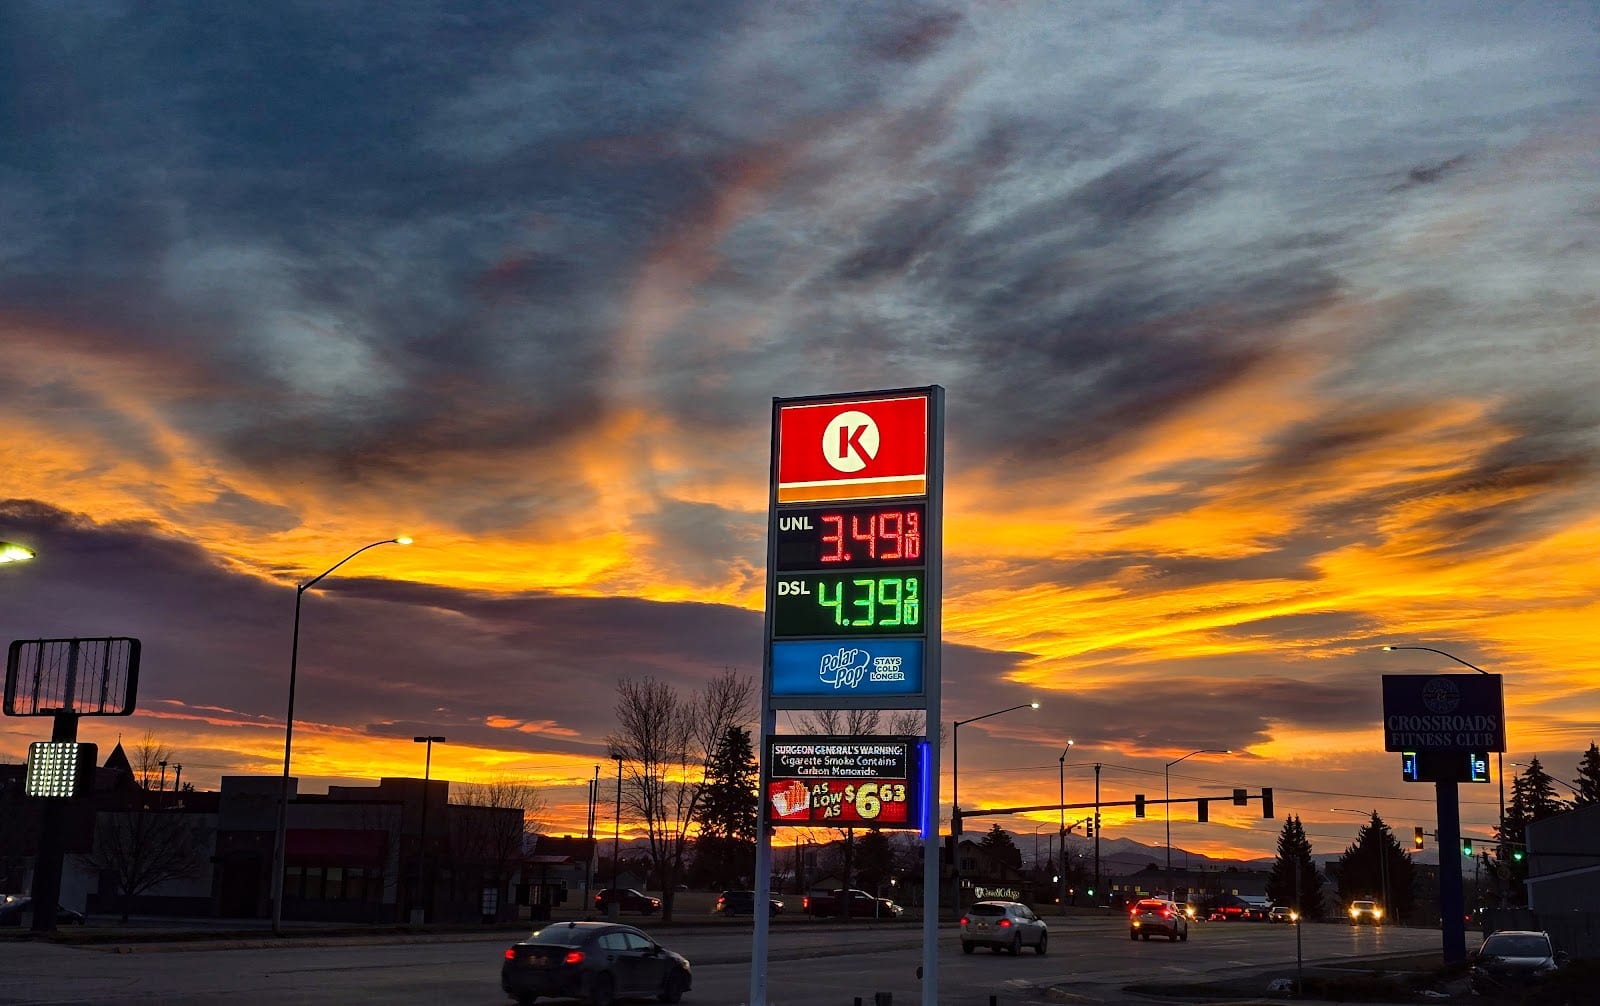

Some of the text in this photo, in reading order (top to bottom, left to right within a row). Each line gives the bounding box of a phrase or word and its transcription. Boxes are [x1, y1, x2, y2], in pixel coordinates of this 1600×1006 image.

[779, 517, 813, 531] UNL
[777, 581, 811, 596] DSL
[820, 648, 859, 674] Polar
[874, 657, 902, 666] STAYS
[876, 665, 899, 673] COLD
[834, 665, 865, 689] Pop
[870, 672, 905, 682] LONGER
[1388, 715, 1497, 732] CROSSROADS
[1391, 733, 1495, 746] FITNESS CLUB
[775, 745, 815, 755] SURGEON
[815, 745, 859, 755] GENERAL'S
[781, 756, 897, 767] Cigarette Smoke Contains
[797, 766, 879, 776] Carbon Monoxide.
[812, 782, 829, 794] AS
[813, 792, 843, 809] LOW
[824, 805, 842, 819] AS
